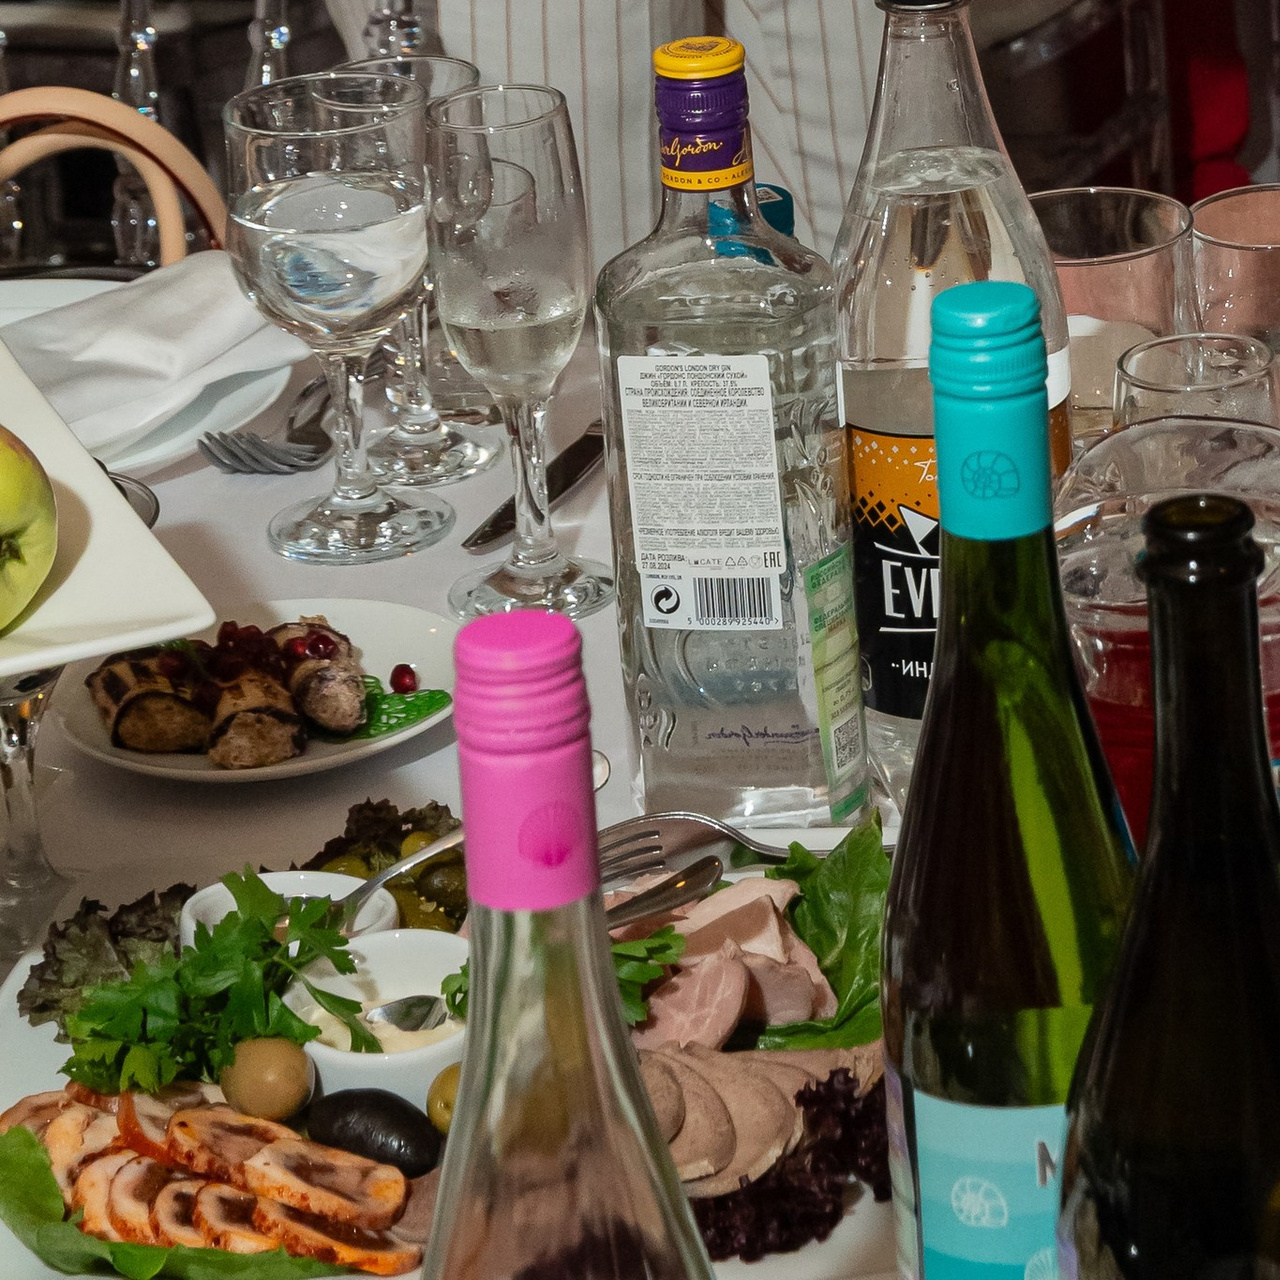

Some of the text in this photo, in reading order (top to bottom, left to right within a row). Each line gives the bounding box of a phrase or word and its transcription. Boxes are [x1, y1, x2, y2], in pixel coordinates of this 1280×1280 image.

[655, 364, 732, 373] GORDON'S LONDON DRY GIN
[640, 372, 657, 380] ДЖИН
[625, 387, 643, 397] СТРАНА
[728, 386, 765, 397] КОРОЛЕВСТВО
[642, 398, 688, 408] ВЕЛИКОБРИТАНИИ
[641, 552, 656, 561] ДАТА
[641, 562, 671, 571] 27.08.2024
[688, 617, 693, 626] 5
